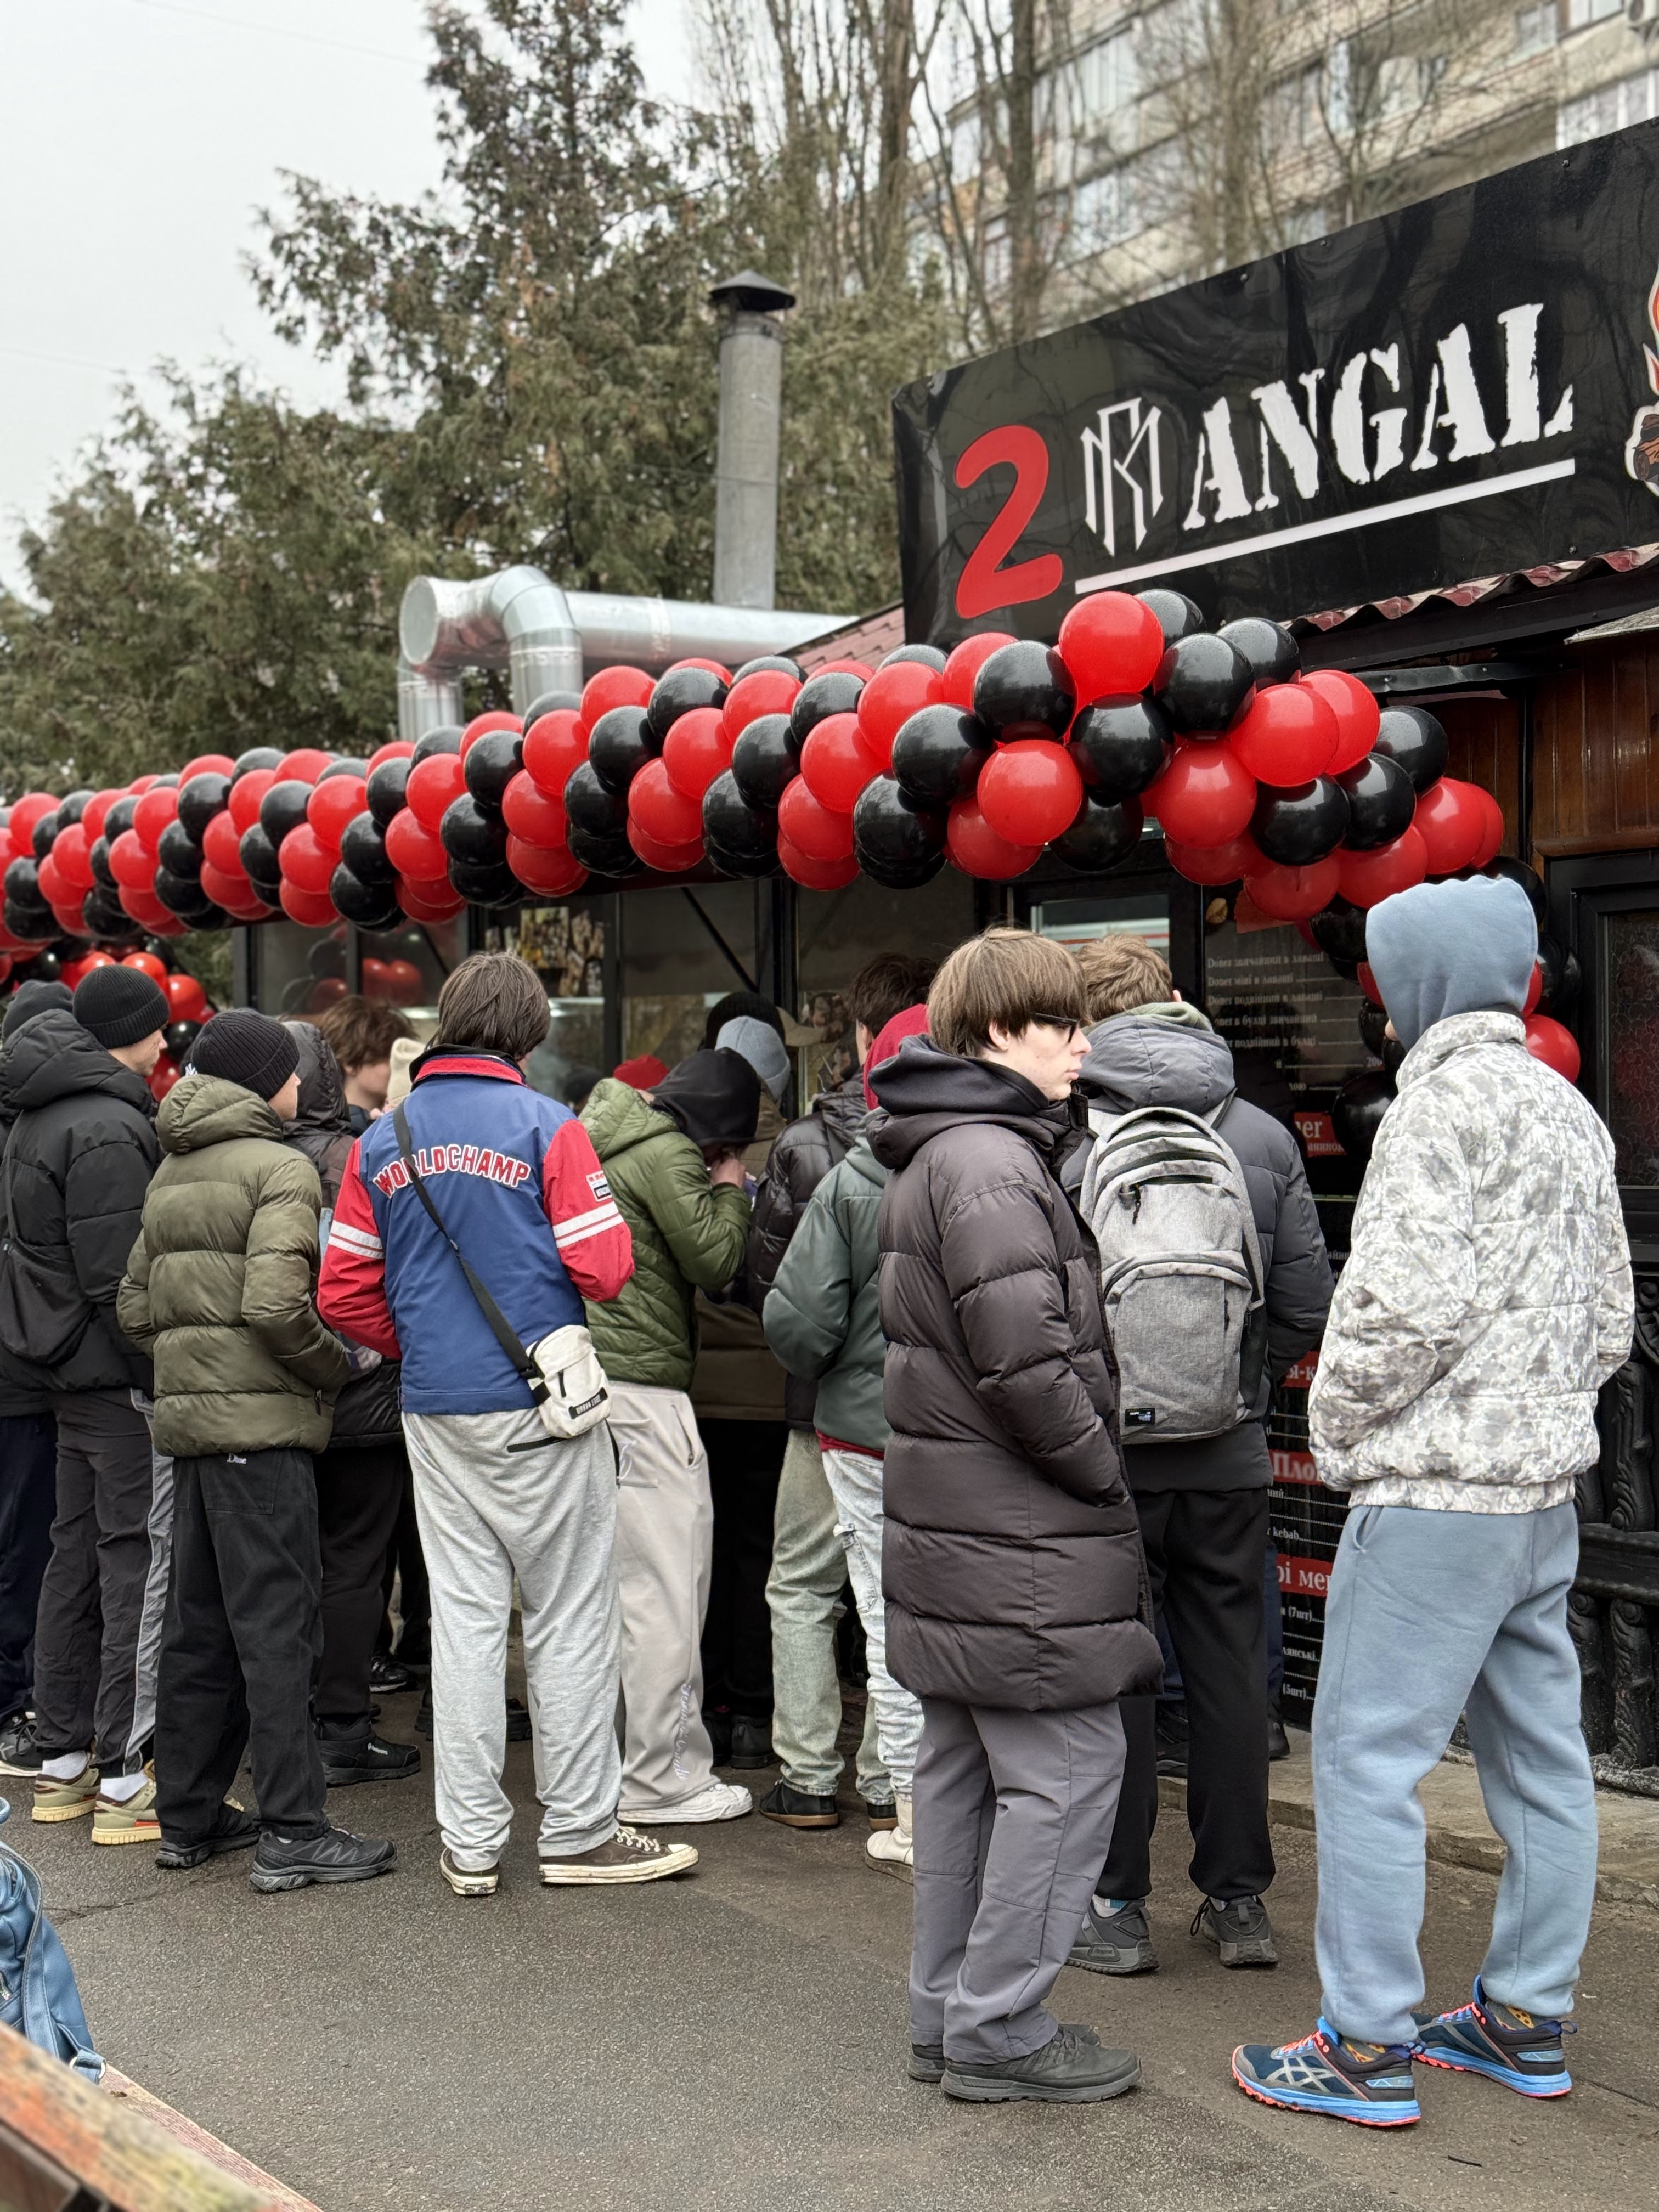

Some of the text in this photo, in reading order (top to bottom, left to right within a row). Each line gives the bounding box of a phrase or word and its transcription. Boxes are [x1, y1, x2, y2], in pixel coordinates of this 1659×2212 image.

[955, 425, 1063, 619] 2
[1273, 1452, 1322, 1481] Пло
[1267, 1488, 1284, 1499] ний
[1273, 1526, 1300, 1541] kebab
